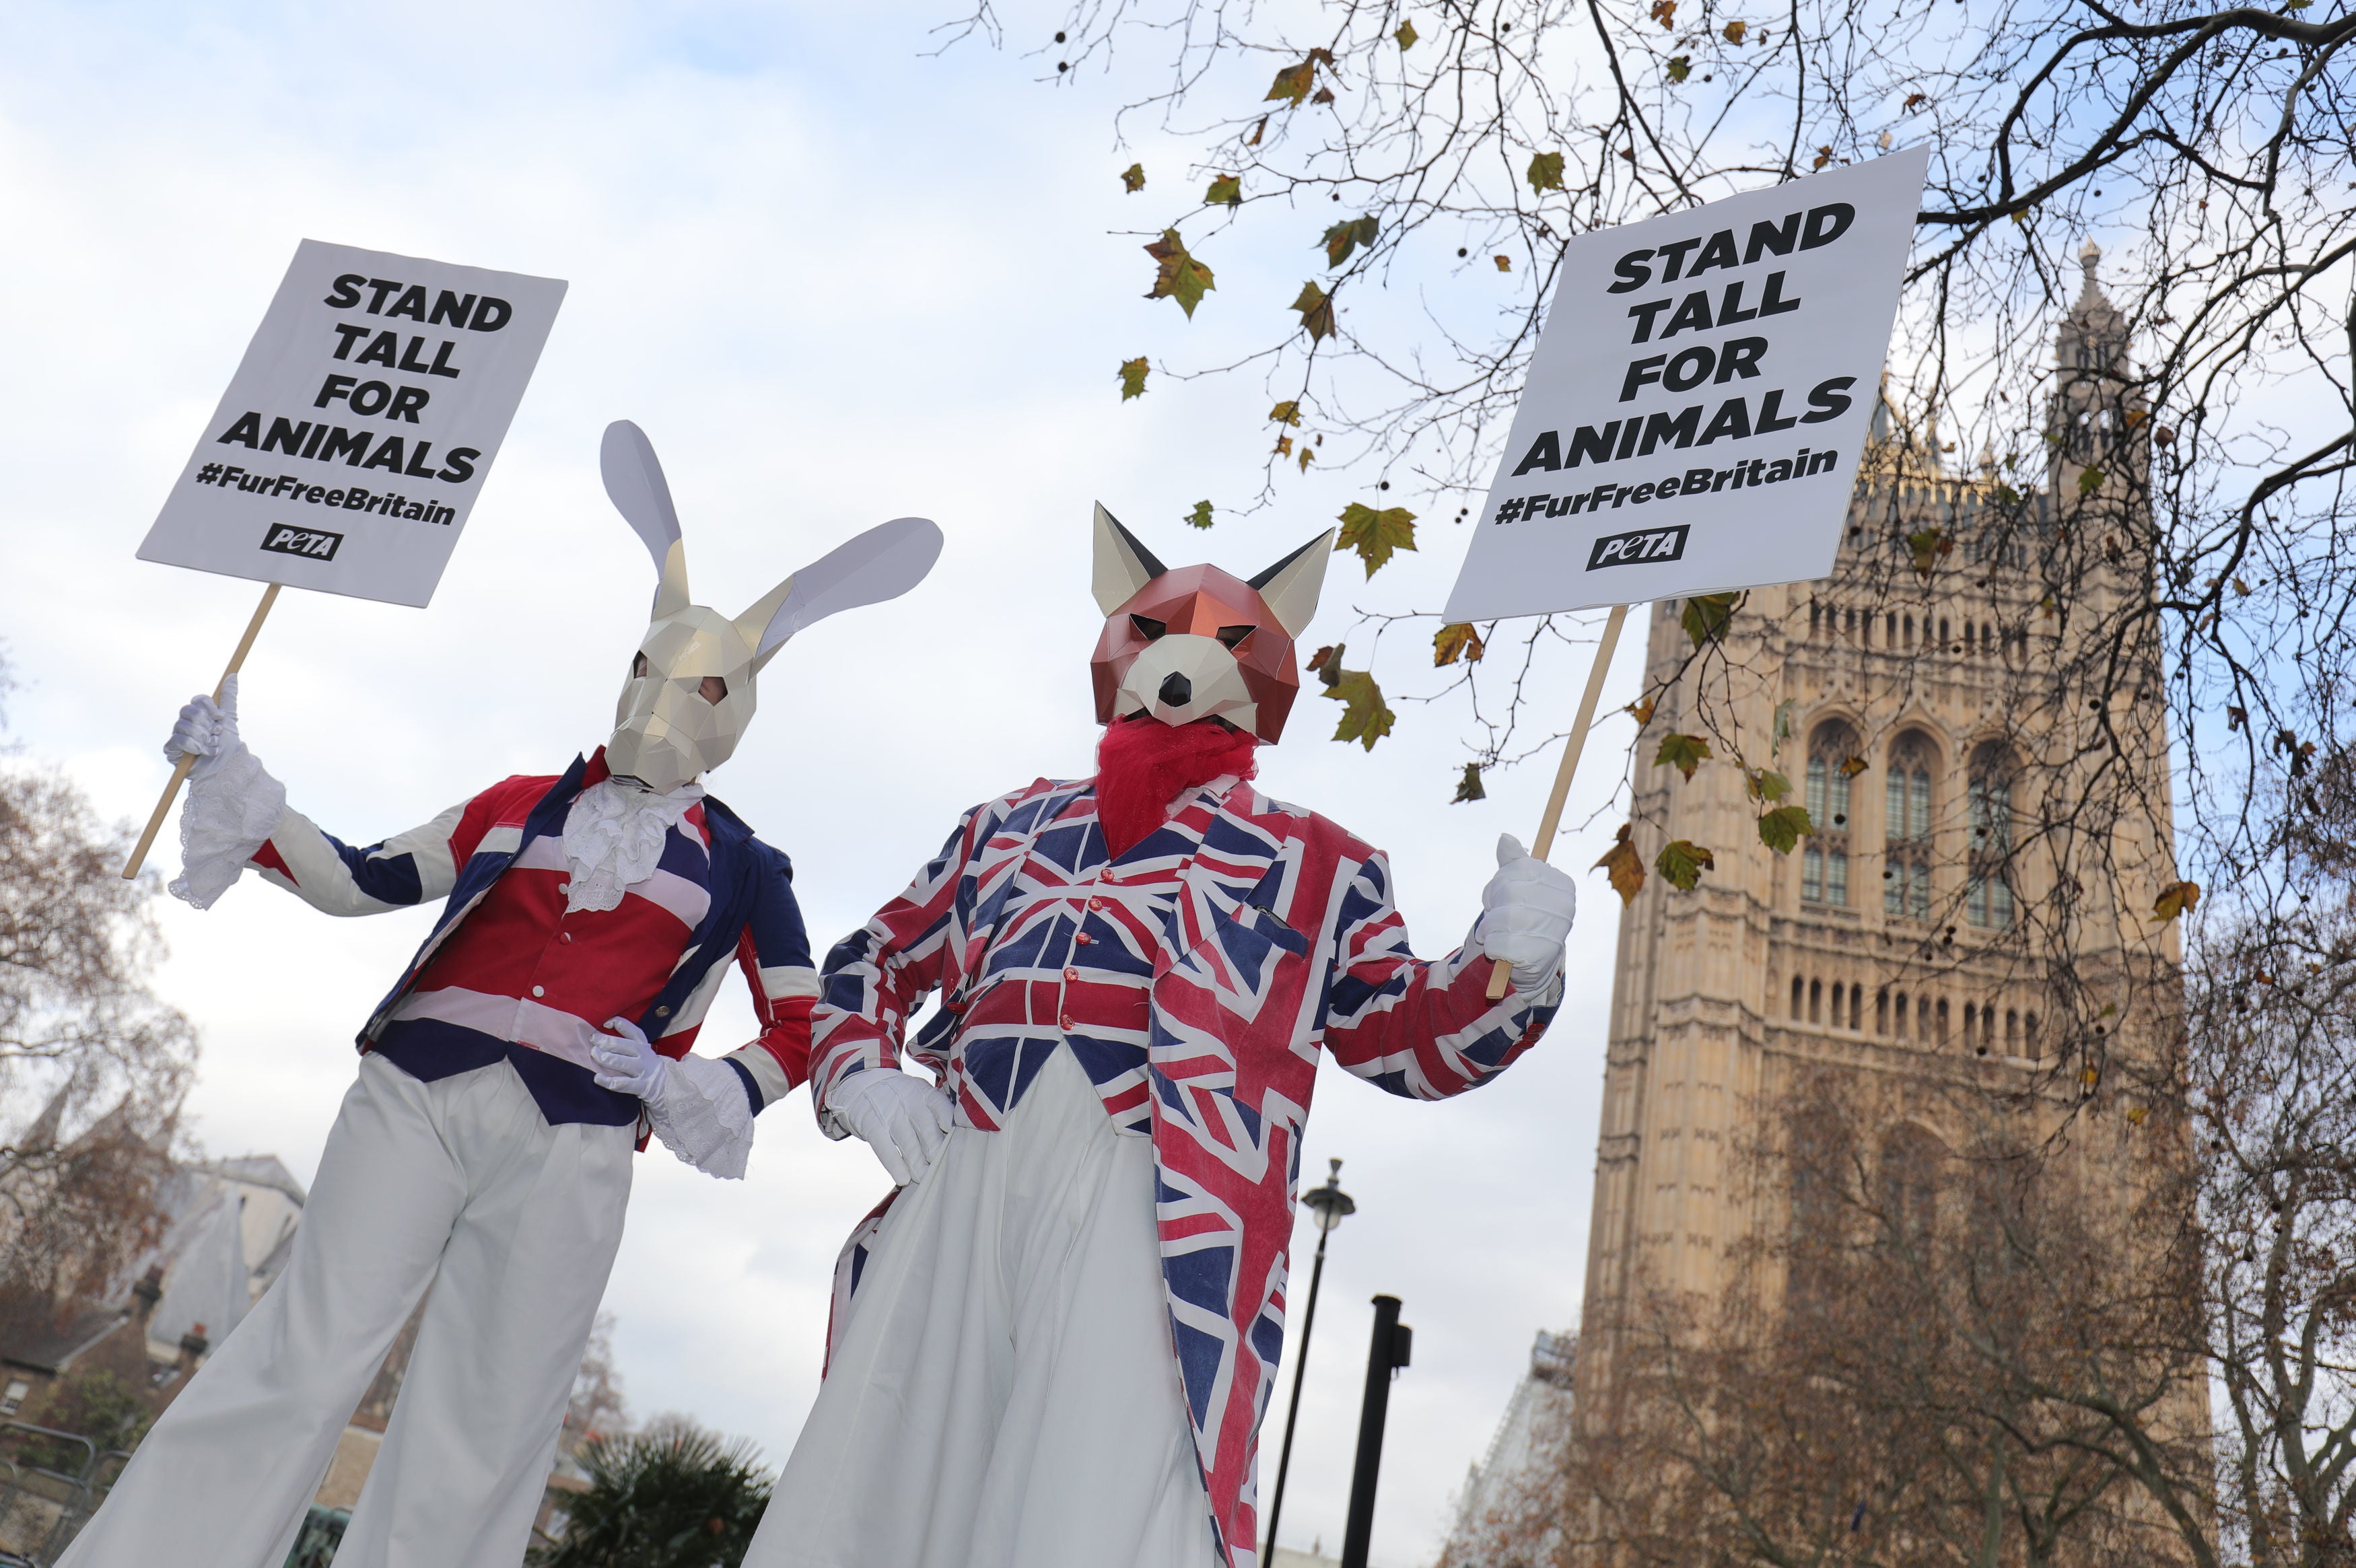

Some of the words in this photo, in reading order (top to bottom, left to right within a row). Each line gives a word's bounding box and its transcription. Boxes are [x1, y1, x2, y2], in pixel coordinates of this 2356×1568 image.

[1606, 203, 1856, 294] STAND
[324, 273, 512, 332] STAND
[1627, 270, 1801, 345] TALL
[333, 322, 460, 379] TALL
[1618, 336, 1768, 403] FOR
[313, 373, 430, 424] FOR
[1511, 376, 1858, 477] ANIMALS
[216, 411, 482, 484] ANIMALS
[196, 462, 456, 526] #FurFreeBritain
[1494, 448, 1838, 525] #FurFreeBritain
